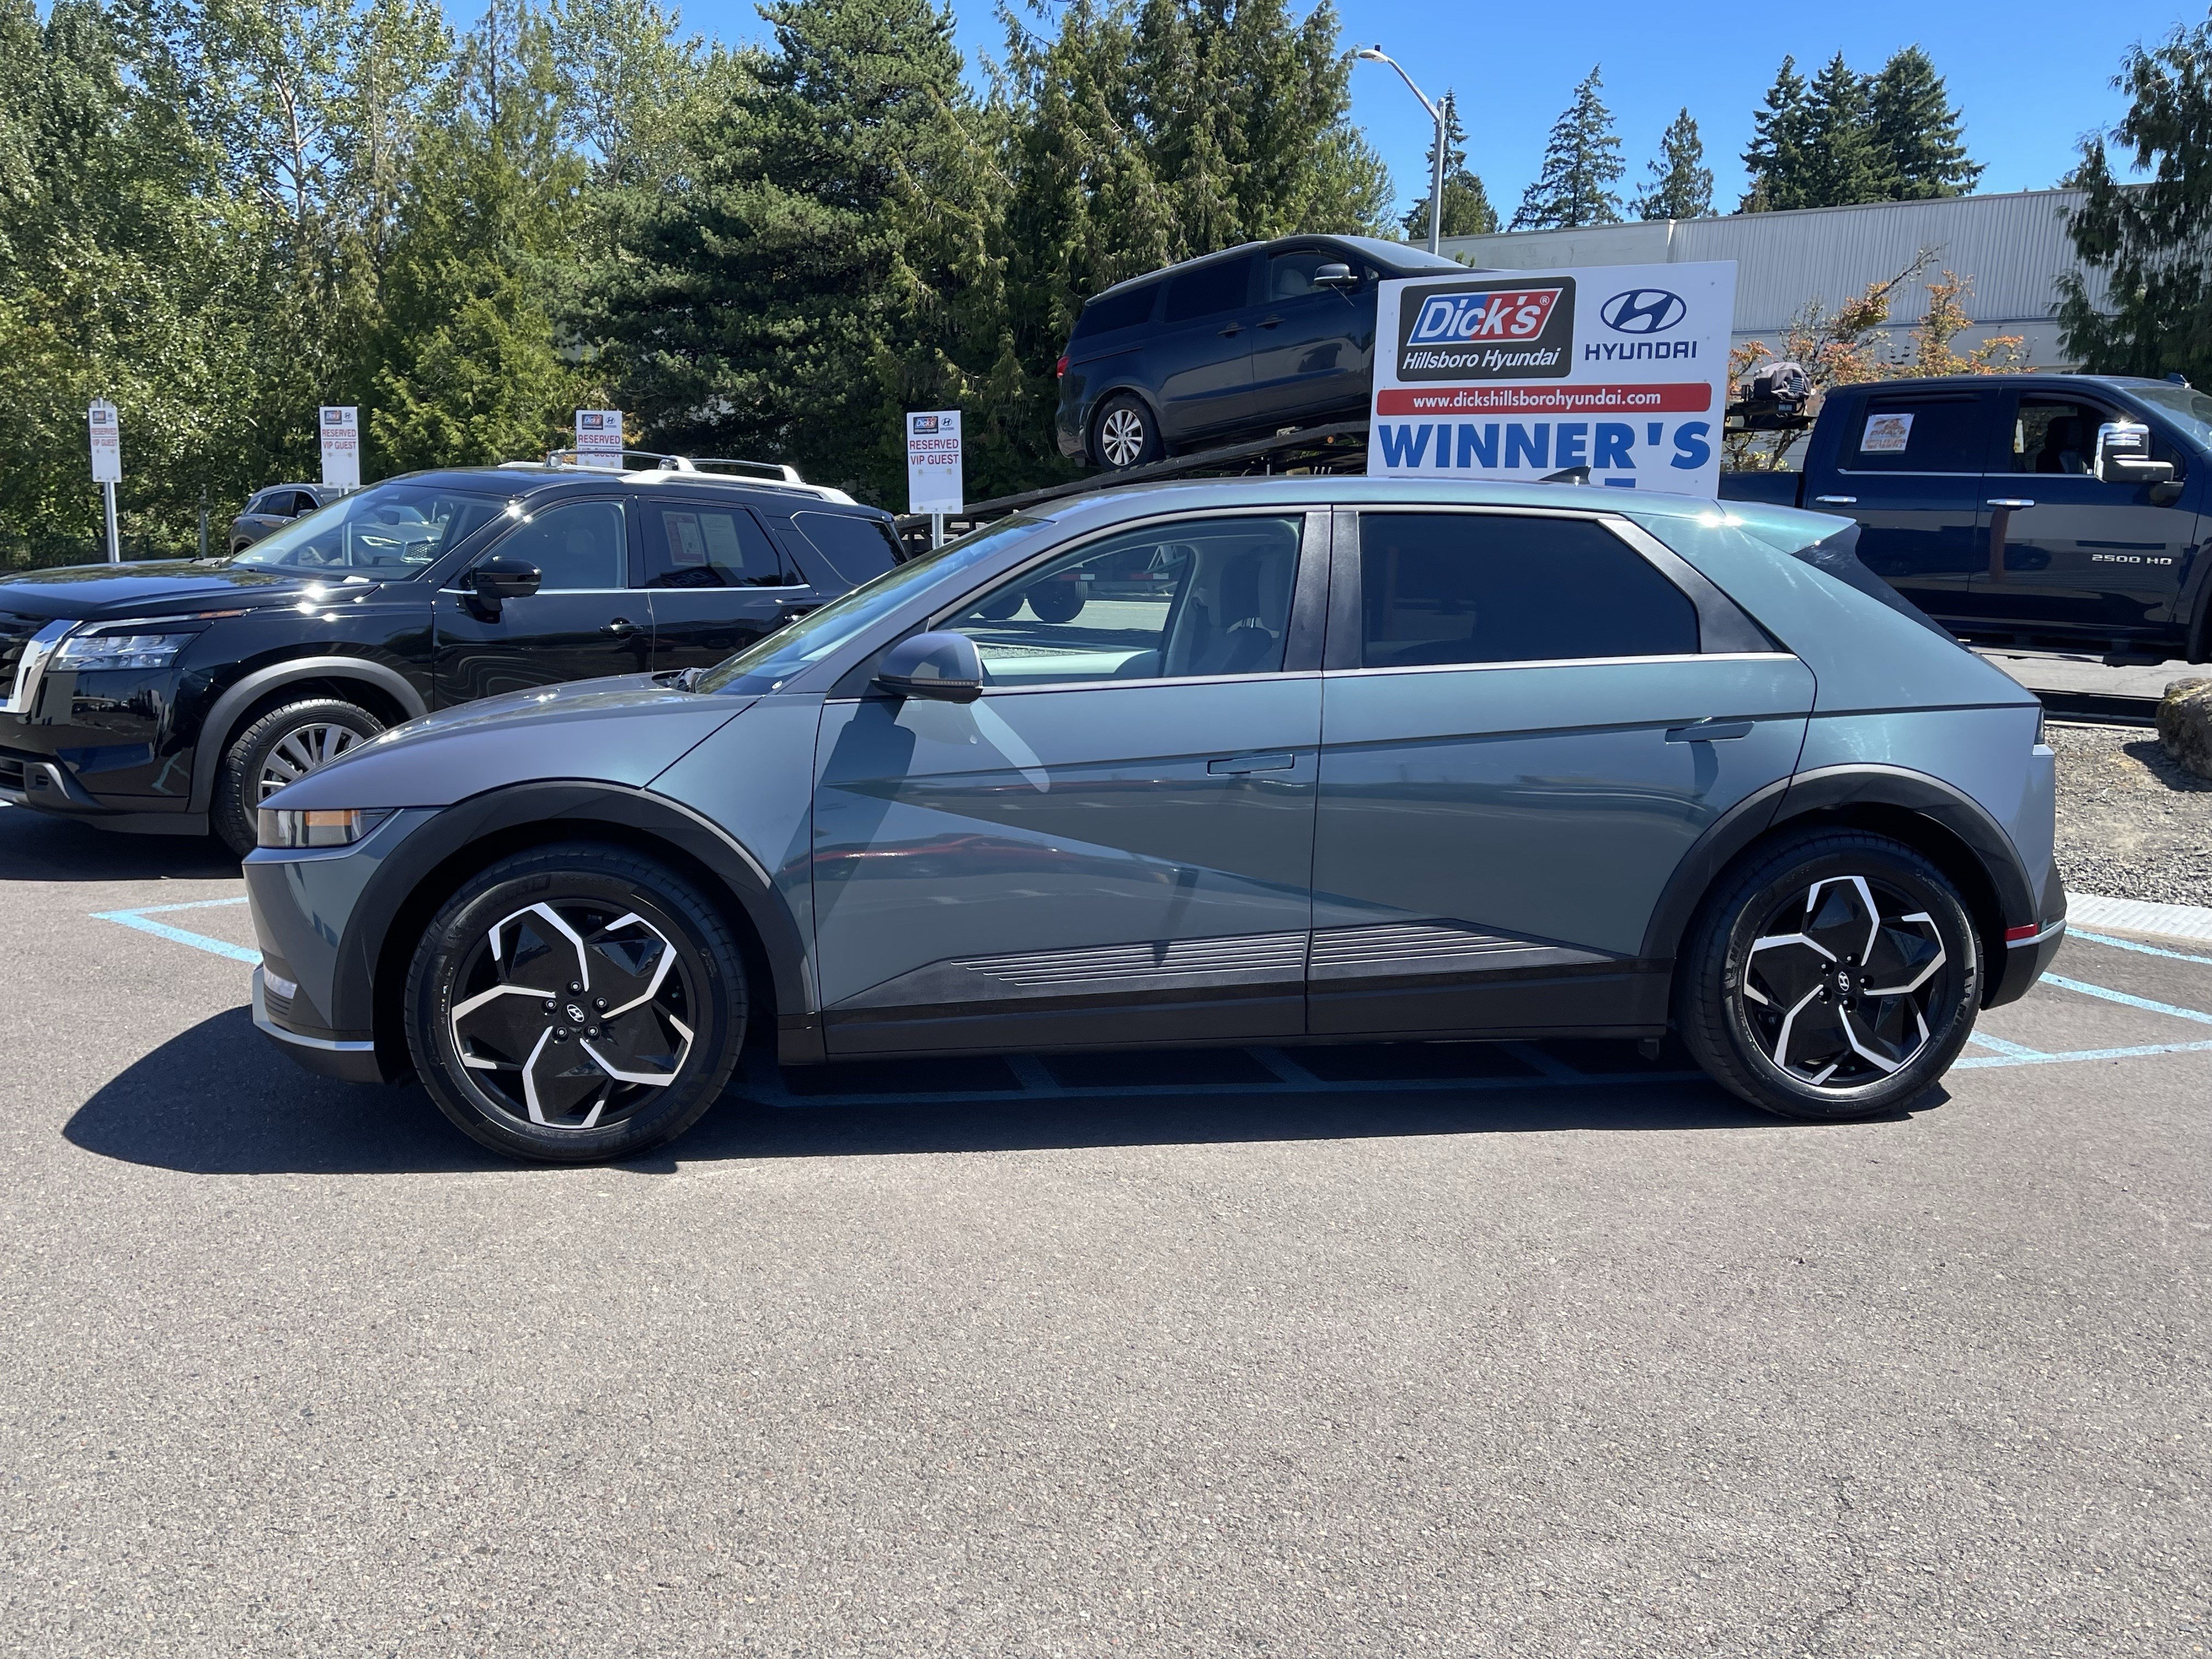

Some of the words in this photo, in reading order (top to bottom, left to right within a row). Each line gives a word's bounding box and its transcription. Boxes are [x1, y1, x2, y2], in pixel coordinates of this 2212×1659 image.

[1585, 341, 1697, 360] HYUNDAI
[1402, 351, 1480, 370] Hillsboro
[1481, 347, 1562, 371] Hyundai
[1413, 388, 1661, 409] www.dickshillsborohyundai.com
[321, 429, 356, 437] RESERVED
[335, 441, 357, 449] GUEST
[578, 435, 620, 444] RESERVED
[910, 439, 959, 450] RESERVED
[1378, 421, 1711, 470] WINNER'S
[910, 455, 925, 465] VIP
[928, 454, 959, 465] GUEST
[2091, 554, 2141, 563] 2500
